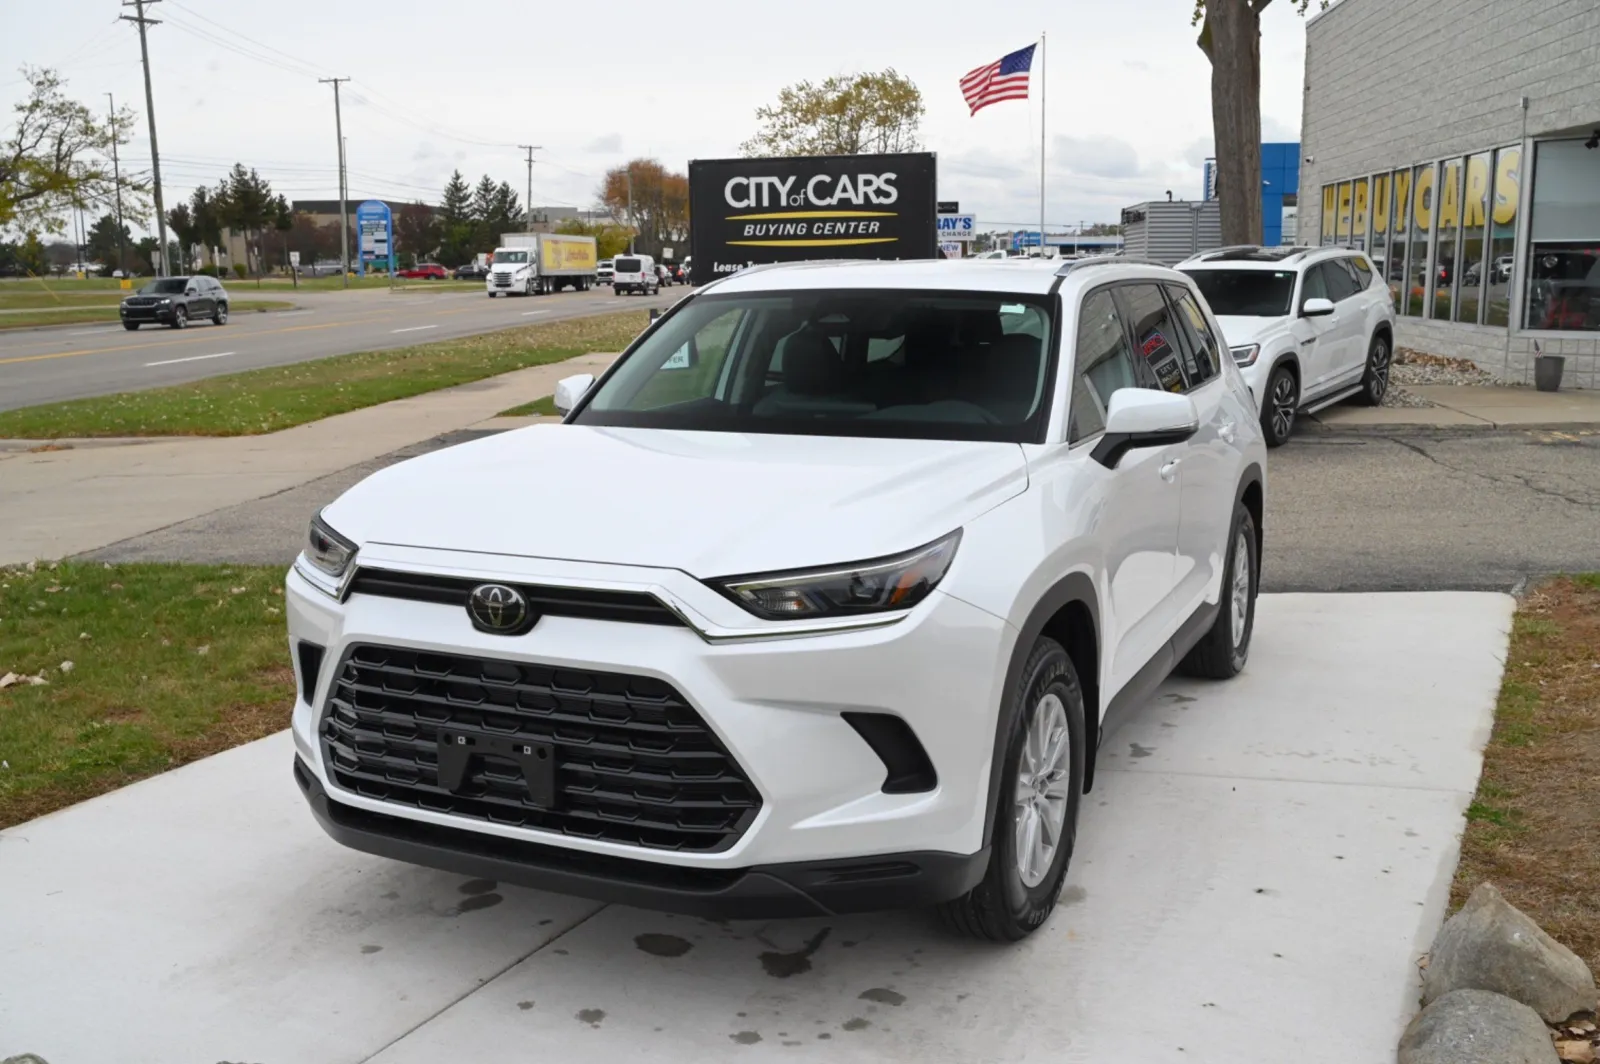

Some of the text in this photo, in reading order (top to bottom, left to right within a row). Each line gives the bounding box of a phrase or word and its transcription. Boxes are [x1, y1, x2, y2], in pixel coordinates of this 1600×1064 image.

[724, 172, 898, 208] CITY of CARS
[1353, 171, 1411, 235] BUY
[1414, 149, 1521, 230] CARS
[743, 221, 880, 236] BUYING CENTER
[713, 261, 744, 273] Lease
